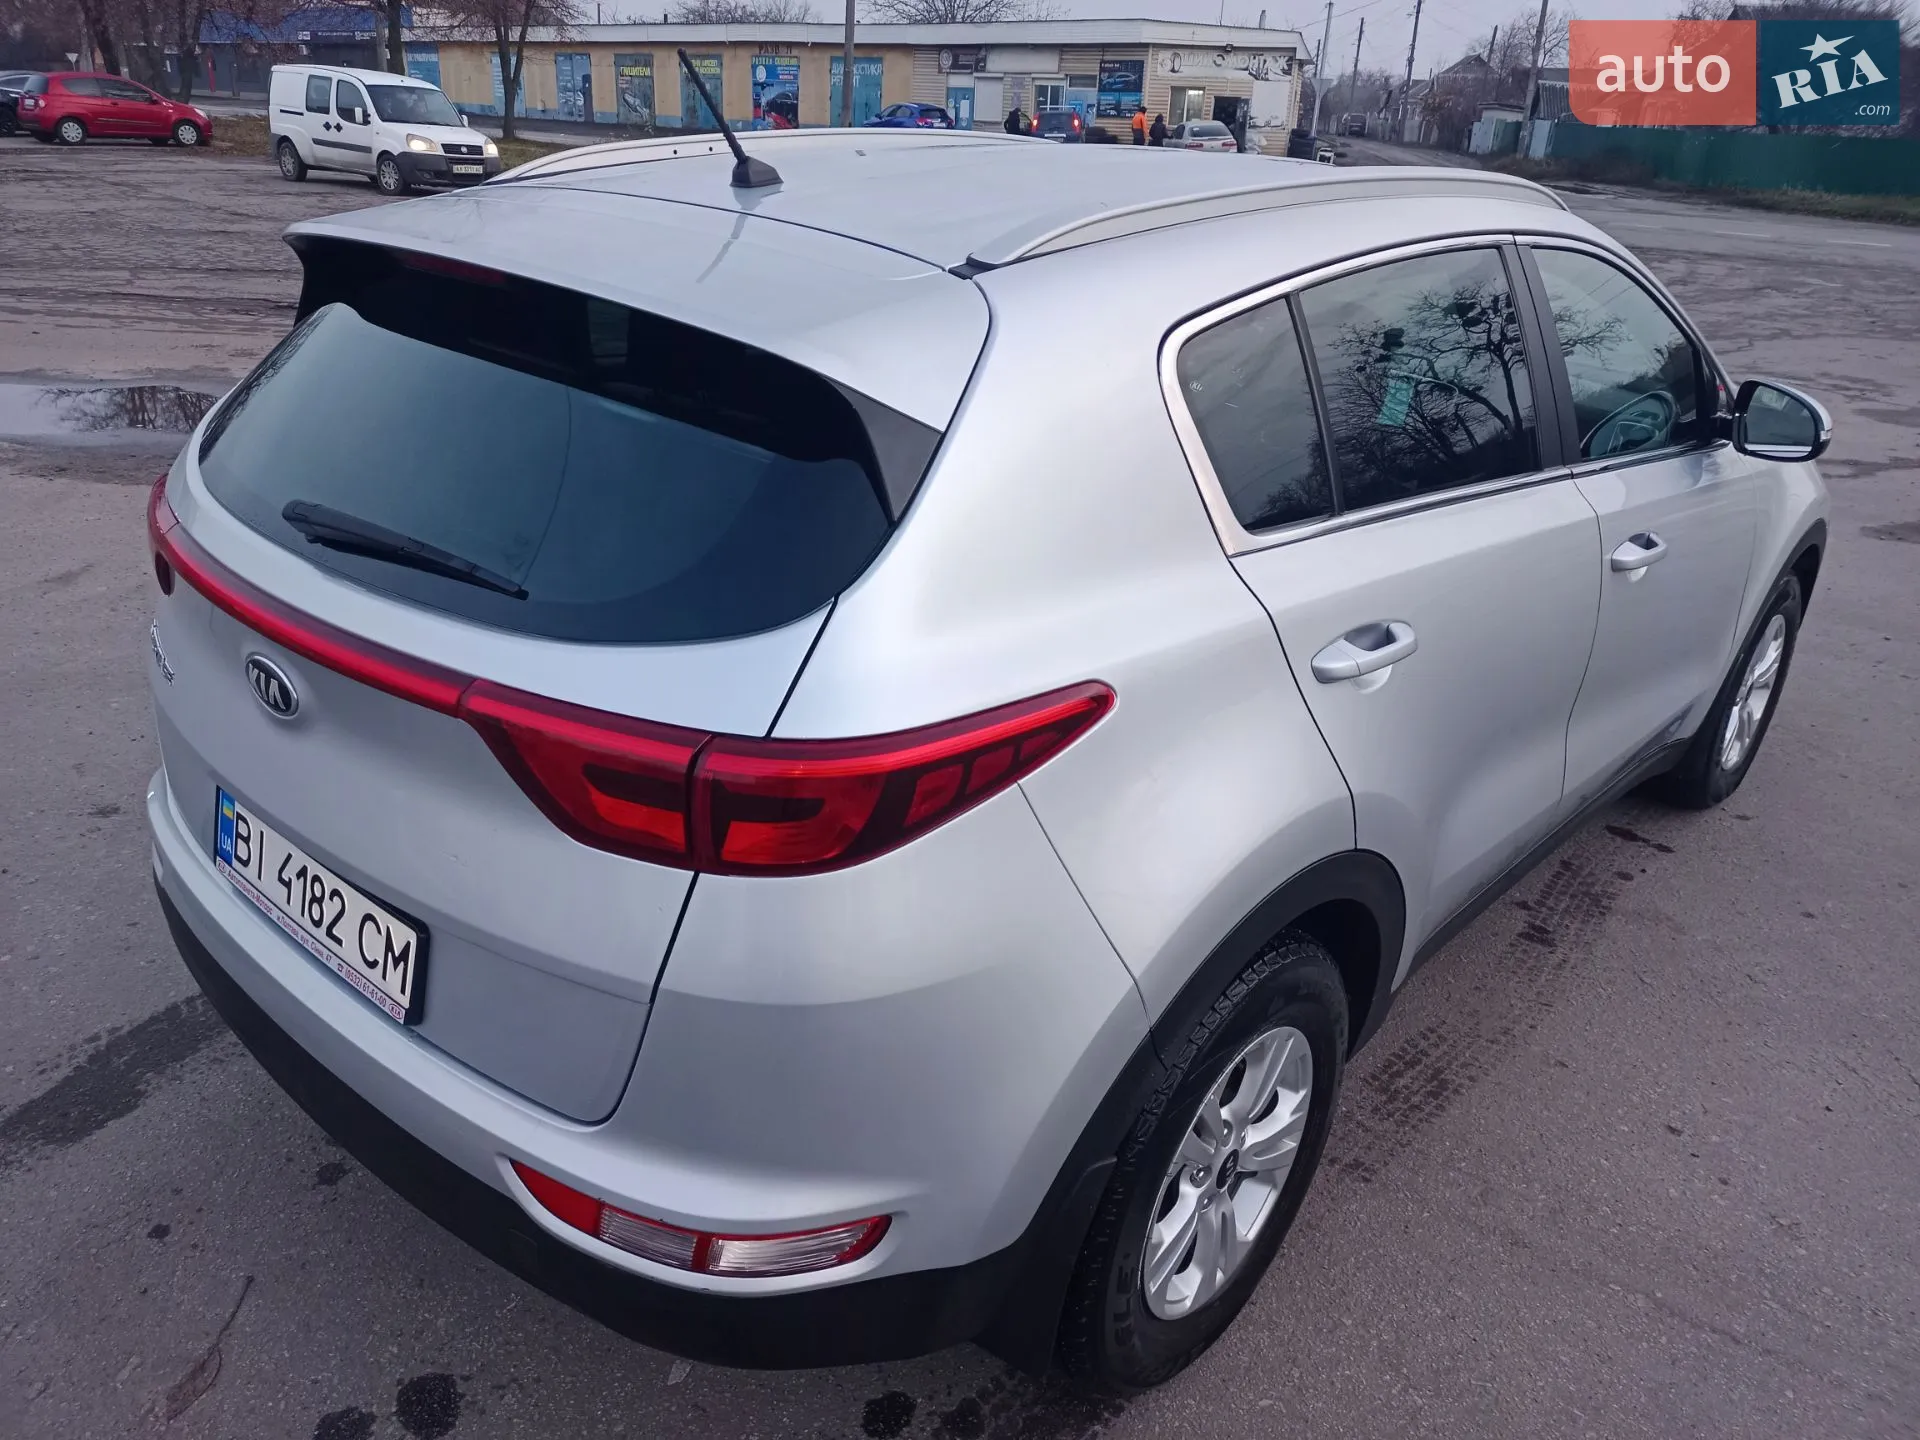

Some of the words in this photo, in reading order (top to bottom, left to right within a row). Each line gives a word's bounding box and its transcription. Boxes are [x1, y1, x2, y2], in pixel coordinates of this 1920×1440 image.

[831, 63, 882, 76] ДИОСТИКА
[248, 663, 286, 710] KIA
[221, 832, 232, 854] UA
[234, 811, 264, 881] BI
[278, 852, 346, 948] 4182
[358, 912, 412, 996] CM
[345, 966, 362, 990] (0532)
[362, 982, 387, 1008] 61-61-00
